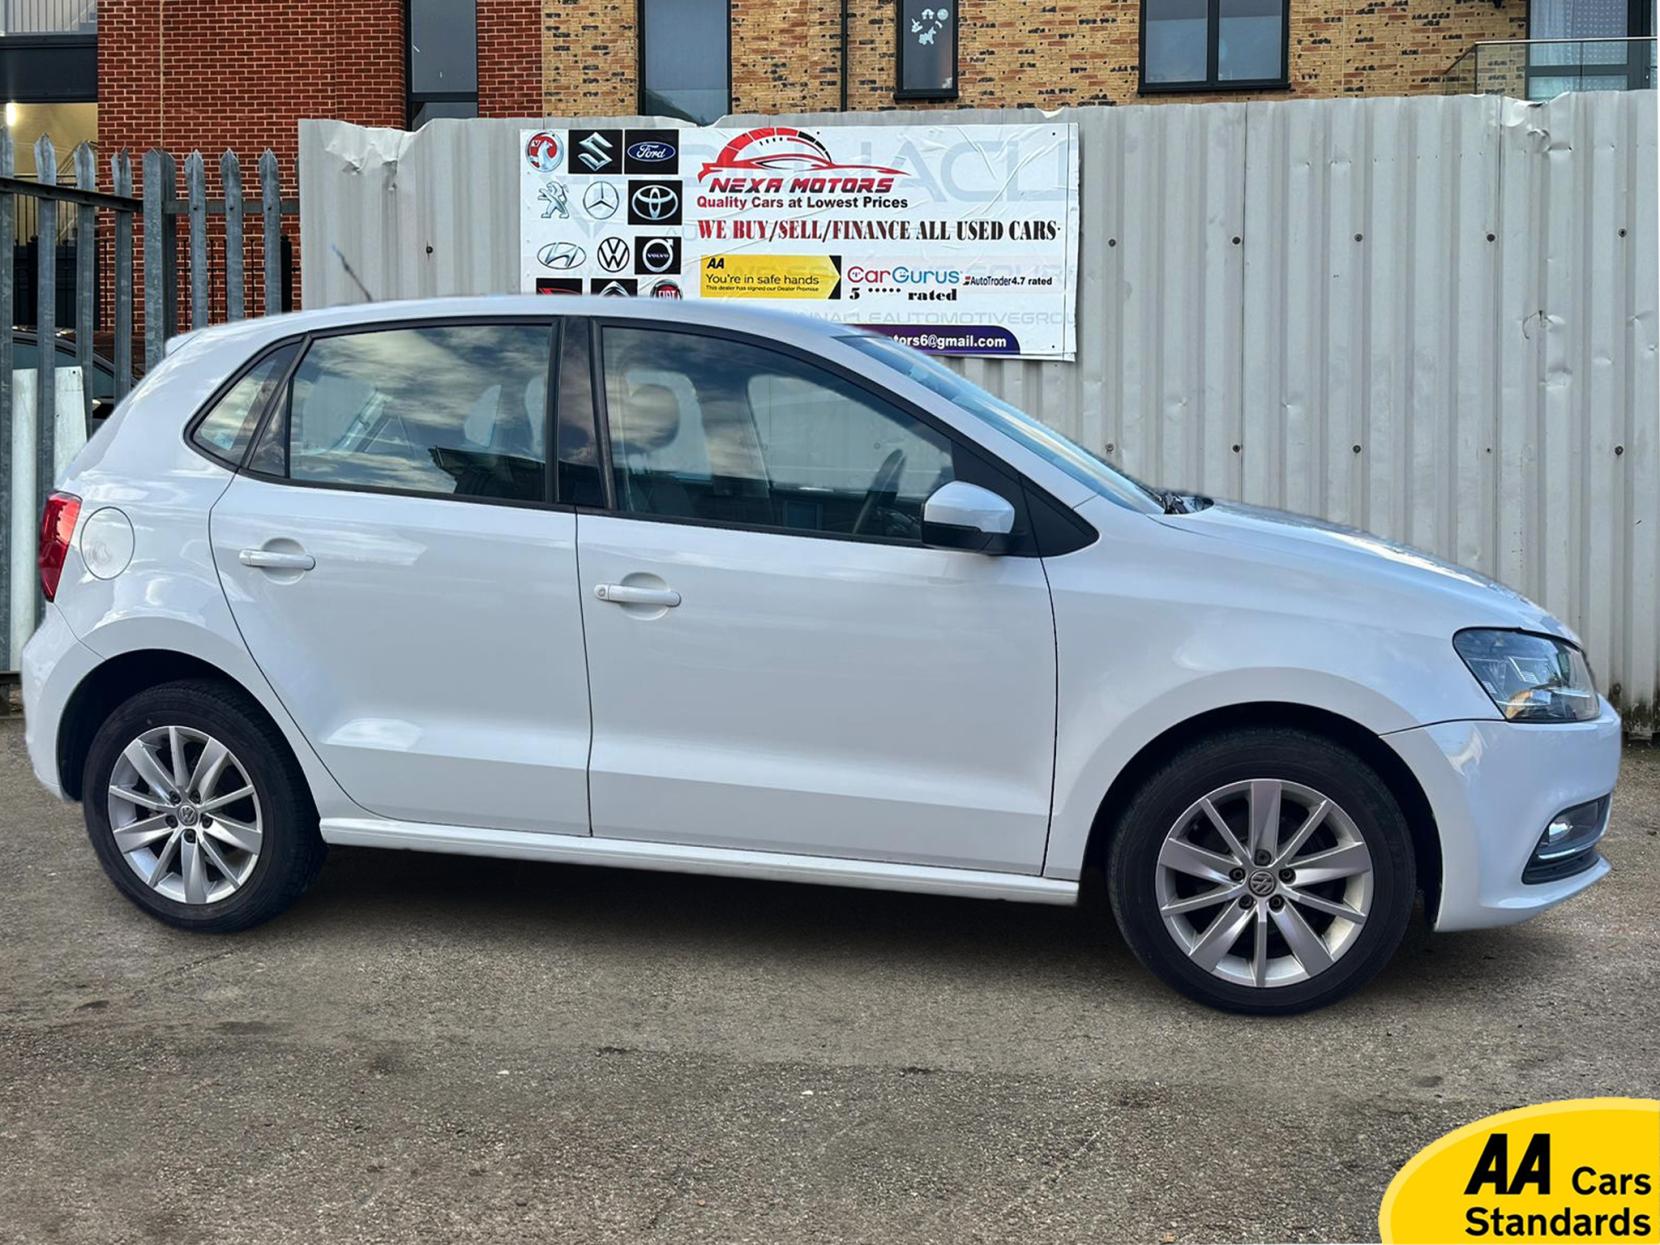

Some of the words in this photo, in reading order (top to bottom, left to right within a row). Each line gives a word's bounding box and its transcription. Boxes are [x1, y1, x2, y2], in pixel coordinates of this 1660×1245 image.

[636, 145, 666, 159] Ford
[709, 178, 784, 193] NEXA
[789, 178, 894, 193] MOTORS
[697, 196, 747, 210] Quality
[751, 196, 784, 208] Cars
[788, 197, 802, 208] at
[807, 196, 858, 208] Lowest
[863, 196, 908, 208] Prices
[698, 220, 726, 239] WE
[733, 220, 910, 242] BUY/SELL/FINANCE
[917, 221, 950, 240] ALL
[956, 221, 1004, 240] USED
[706, 258, 724, 269] AA
[705, 274, 741, 284] You're
[744, 274, 754, 284] in
[757, 274, 781, 285] safe
[784, 274, 819, 285] hands
[847, 265, 960, 284] CarGurus
[1028, 277, 1053, 286] rated
[849, 287, 861, 300] 5
[908, 288, 958, 301] rated
[889, 334, 1007, 349] tors6@gmail.com
